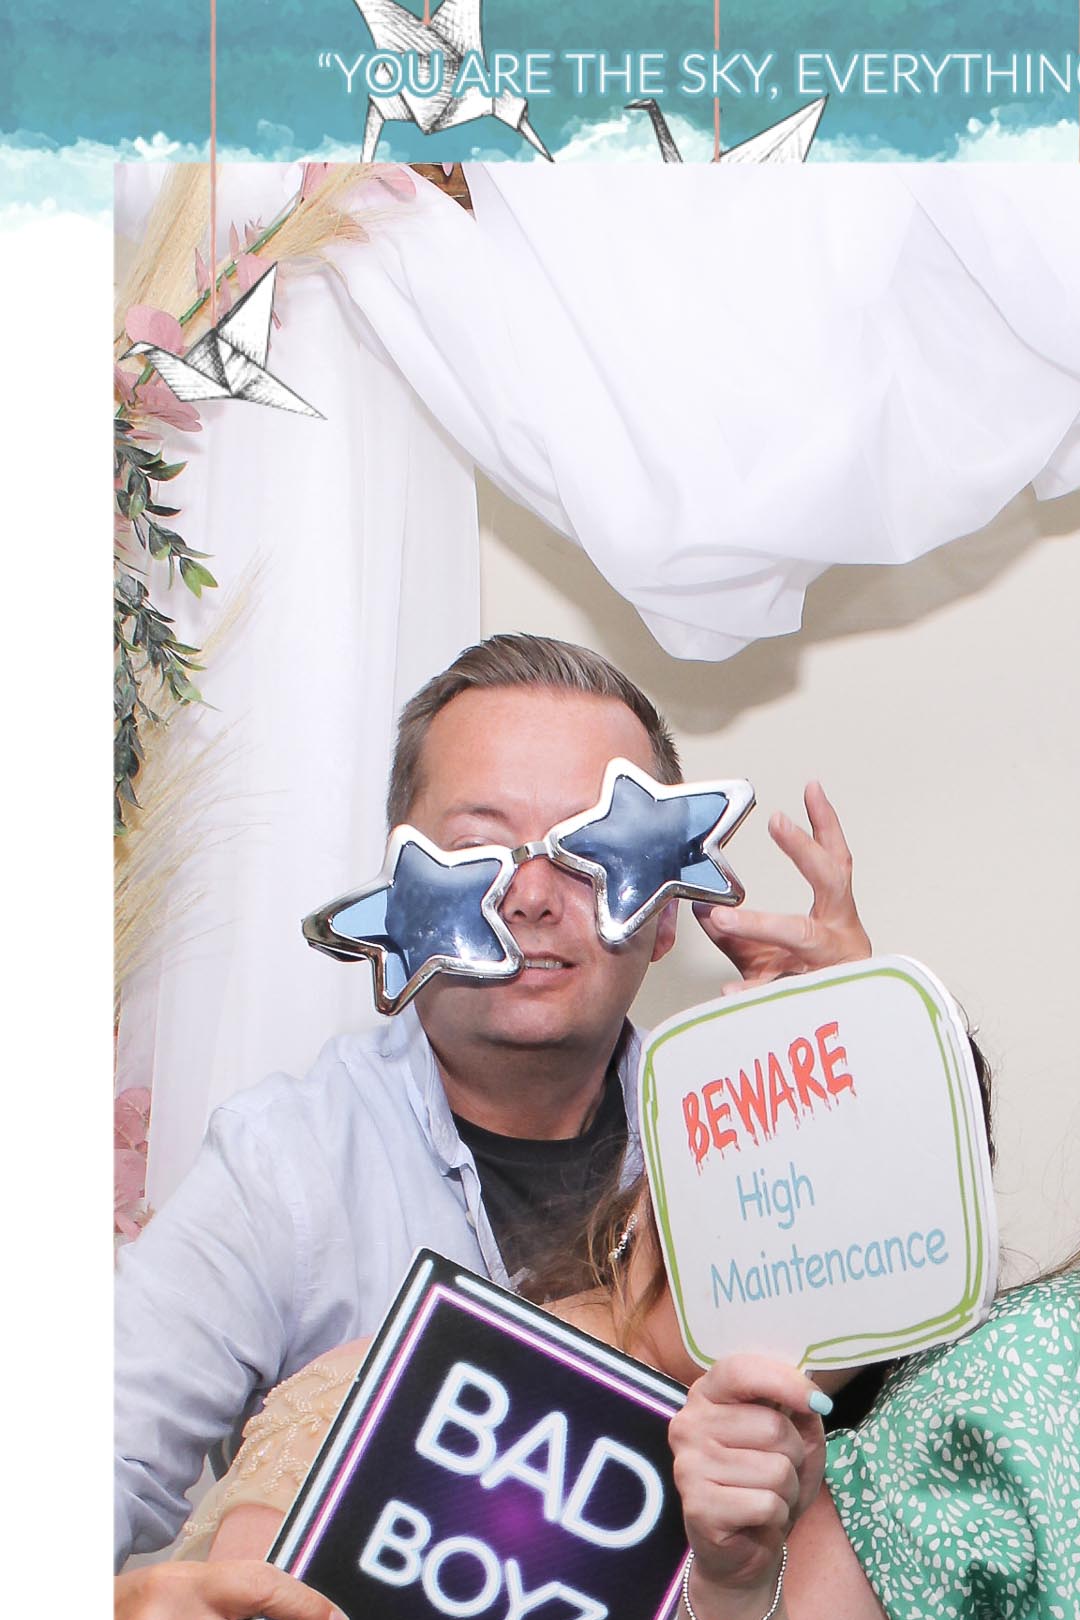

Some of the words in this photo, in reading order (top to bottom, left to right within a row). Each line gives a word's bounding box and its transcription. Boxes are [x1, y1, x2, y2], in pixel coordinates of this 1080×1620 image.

[682, 1020, 857, 1176] BEWARE
[736, 1161, 816, 1230] High
[710, 1227, 949, 1309] Maintencance
[414, 1360, 665, 1550] BAD
